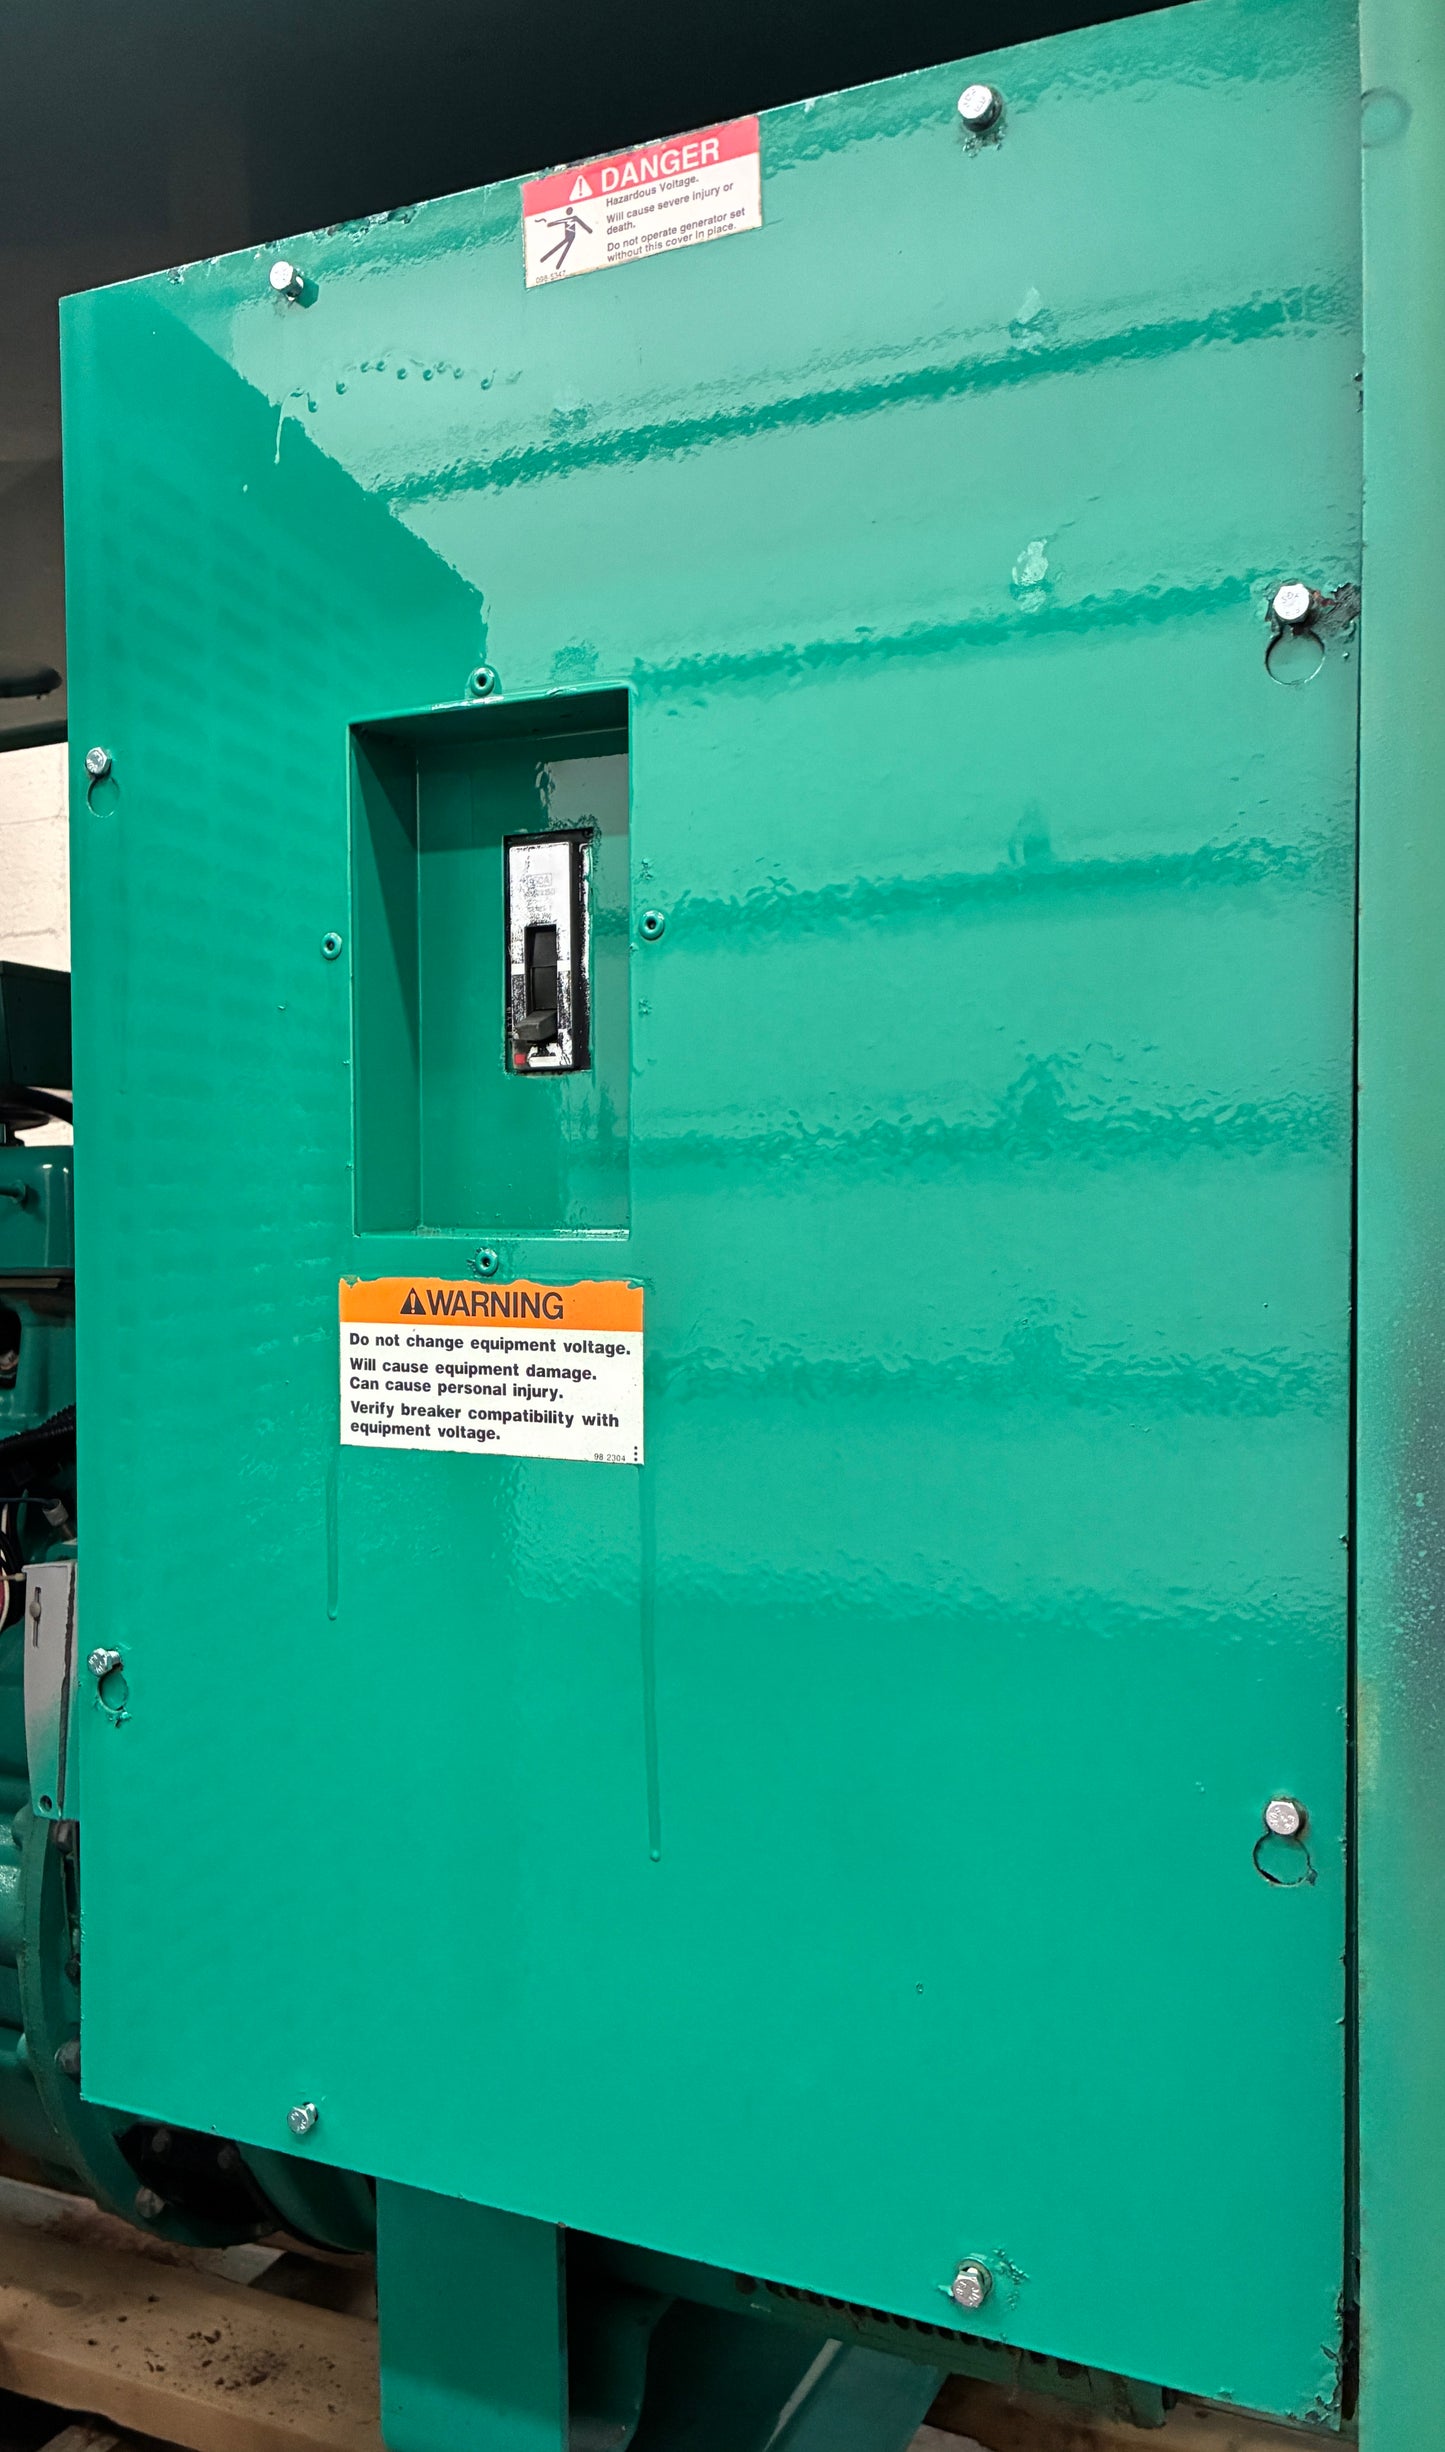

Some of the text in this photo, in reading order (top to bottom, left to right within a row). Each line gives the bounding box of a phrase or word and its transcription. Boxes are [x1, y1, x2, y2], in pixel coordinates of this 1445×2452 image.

[601, 137, 719, 193] DANGER
[606, 176, 699, 207] Hazardous Voltage.
[606, 182, 733, 224] Will cause severe injury or
[607, 221, 636, 235] death.
[608, 208, 745, 252] Do not operate generator set
[608, 224, 736, 262] without this cover in place.
[426, 1290, 564, 1320] WARNING
[350, 1333, 630, 1357] Do not change equipment voltage.
[350, 1358, 597, 1382] Will cause equipment damage.
[350, 1377, 564, 1401] Can cause personal injury.
[350, 1401, 619, 1427] Verify breaker compatibility with
[350, 1421, 500, 1442] equipment voltage.
